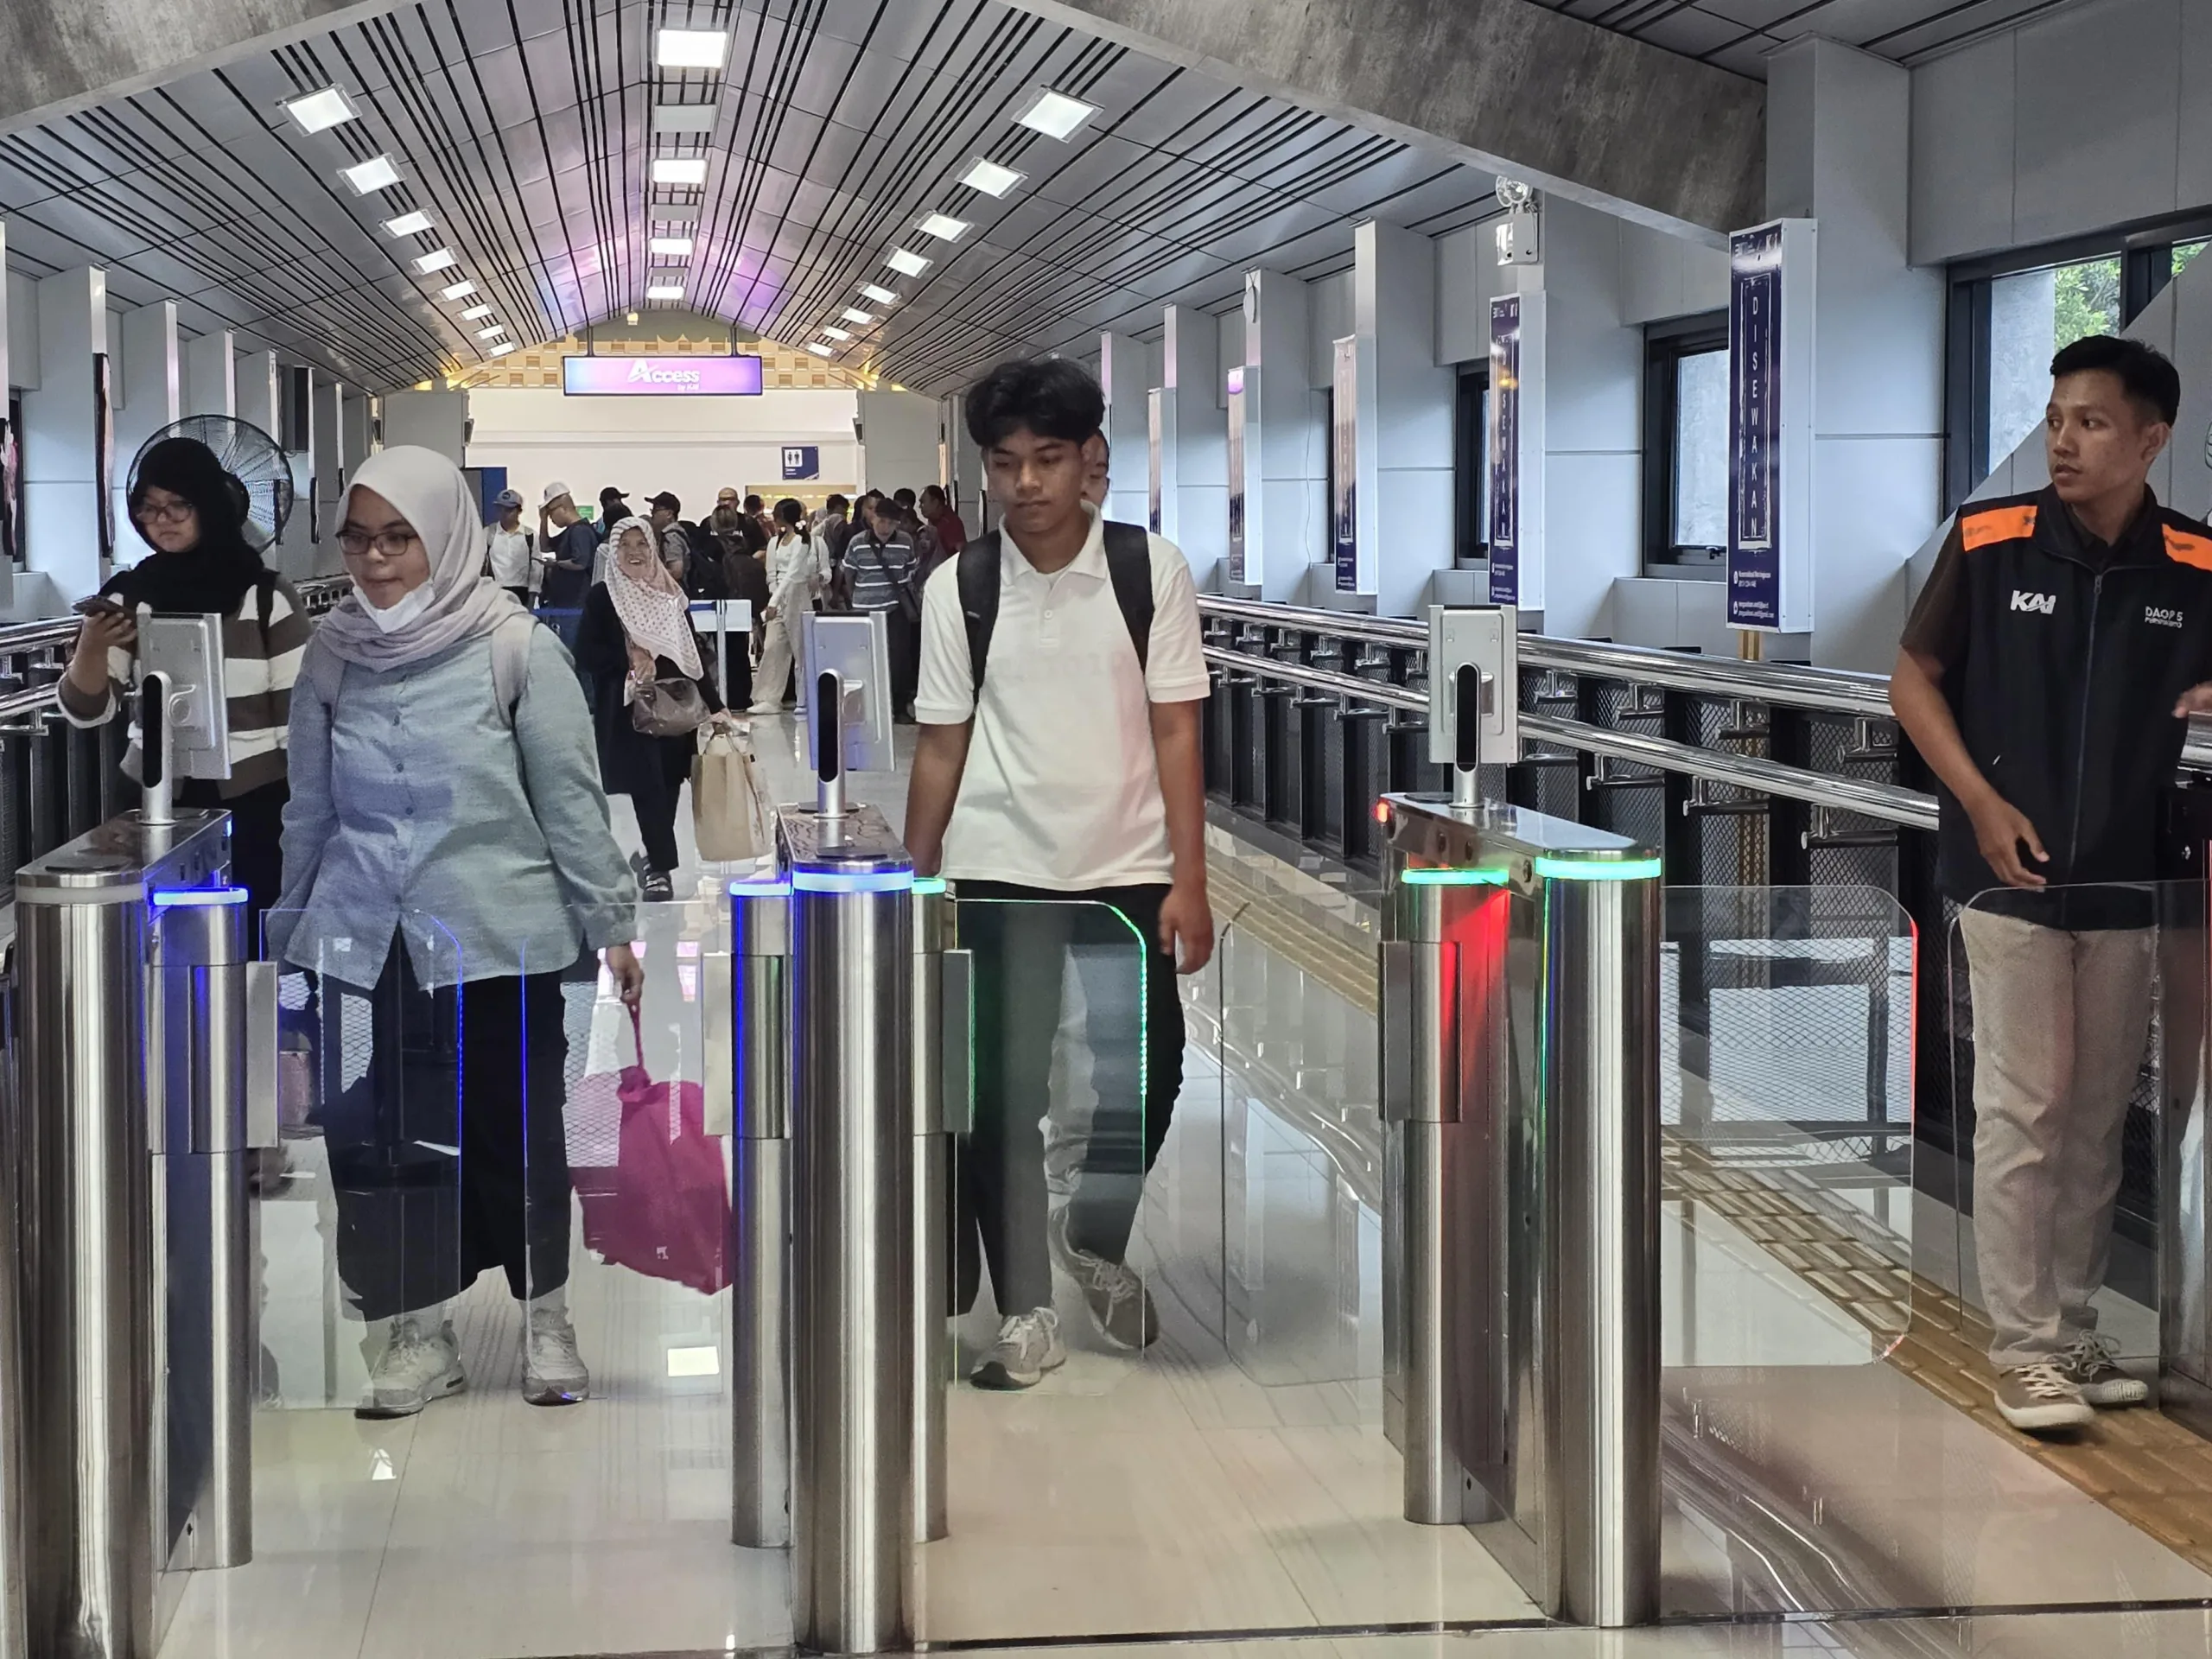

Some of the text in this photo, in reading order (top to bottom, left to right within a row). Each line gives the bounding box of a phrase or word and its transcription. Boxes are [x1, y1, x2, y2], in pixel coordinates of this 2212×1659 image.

[628, 359, 699, 383] Access
[1751, 296, 1759, 537] DISEWAKAN
[2010, 589, 2056, 614] KAI
[2145, 606, 2183, 621] DAOP 5
